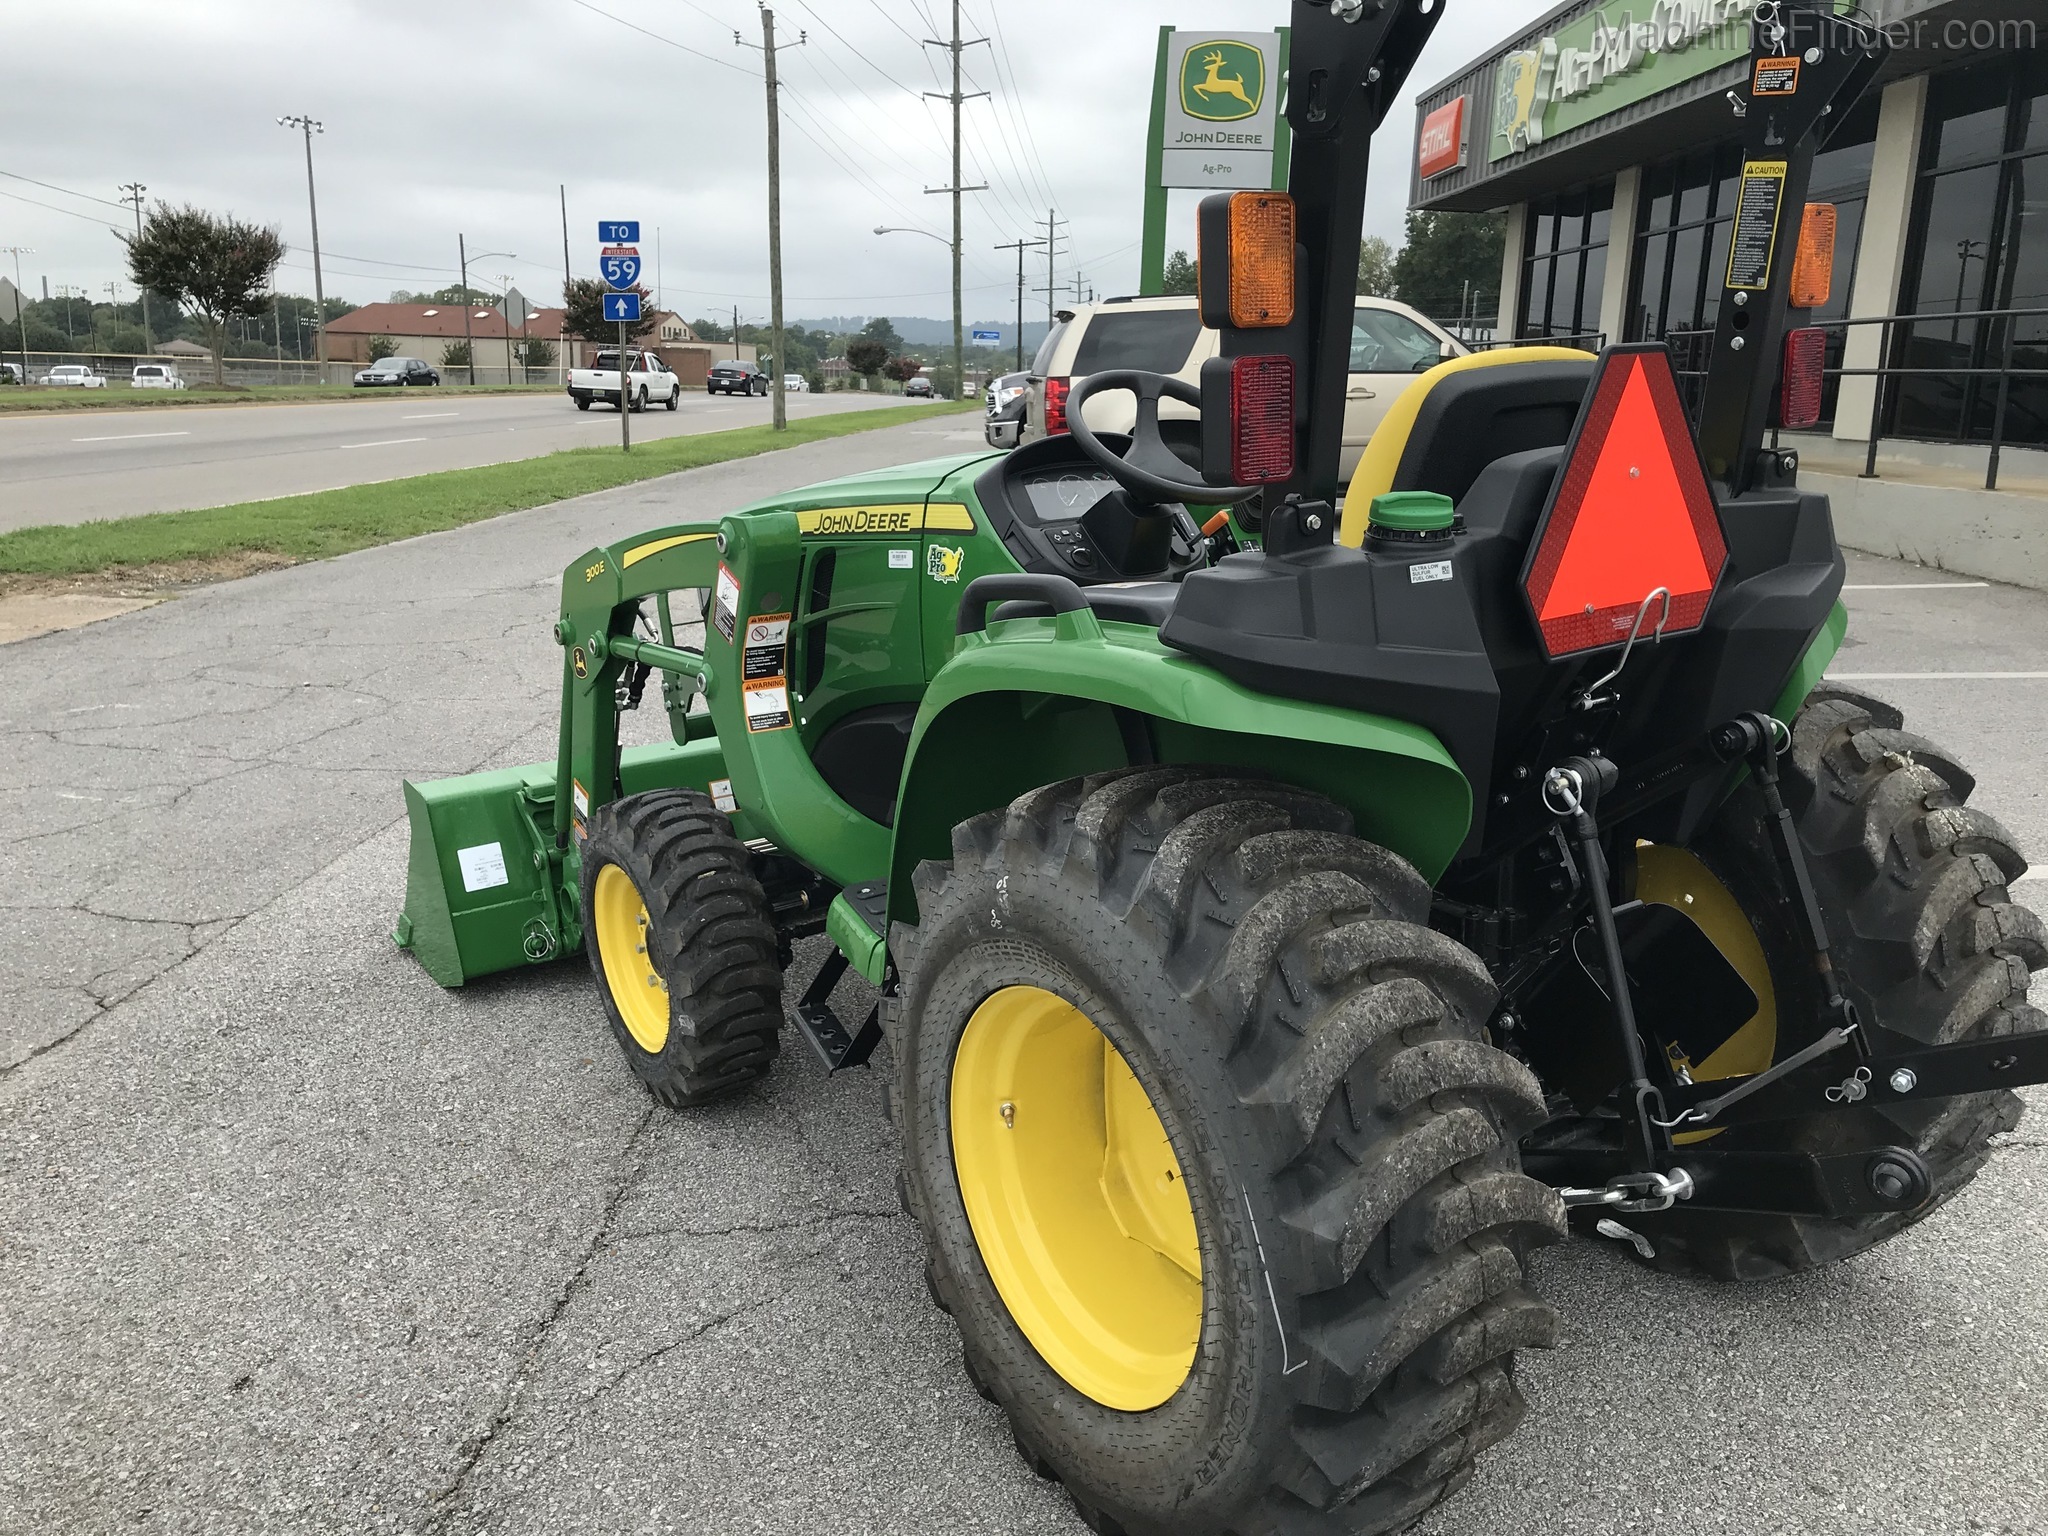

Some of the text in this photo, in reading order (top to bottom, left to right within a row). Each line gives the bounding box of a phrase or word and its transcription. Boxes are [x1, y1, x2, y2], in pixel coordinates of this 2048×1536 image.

[1175, 131, 1262, 144] JOHN DEERE
[1421, 122, 1451, 158] STIHL
[1202, 164, 1232, 175] Ag-Pro
[609, 226, 629, 238] TO
[608, 261, 636, 281] 59
[814, 511, 912, 532] JOHN DEERE
[930, 548, 946, 562] Ag-
[585, 561, 605, 583] 300E
[930, 561, 946, 573] Pro
[758, 614, 790, 622] WARNING
[752, 680, 784, 689] WARNING
